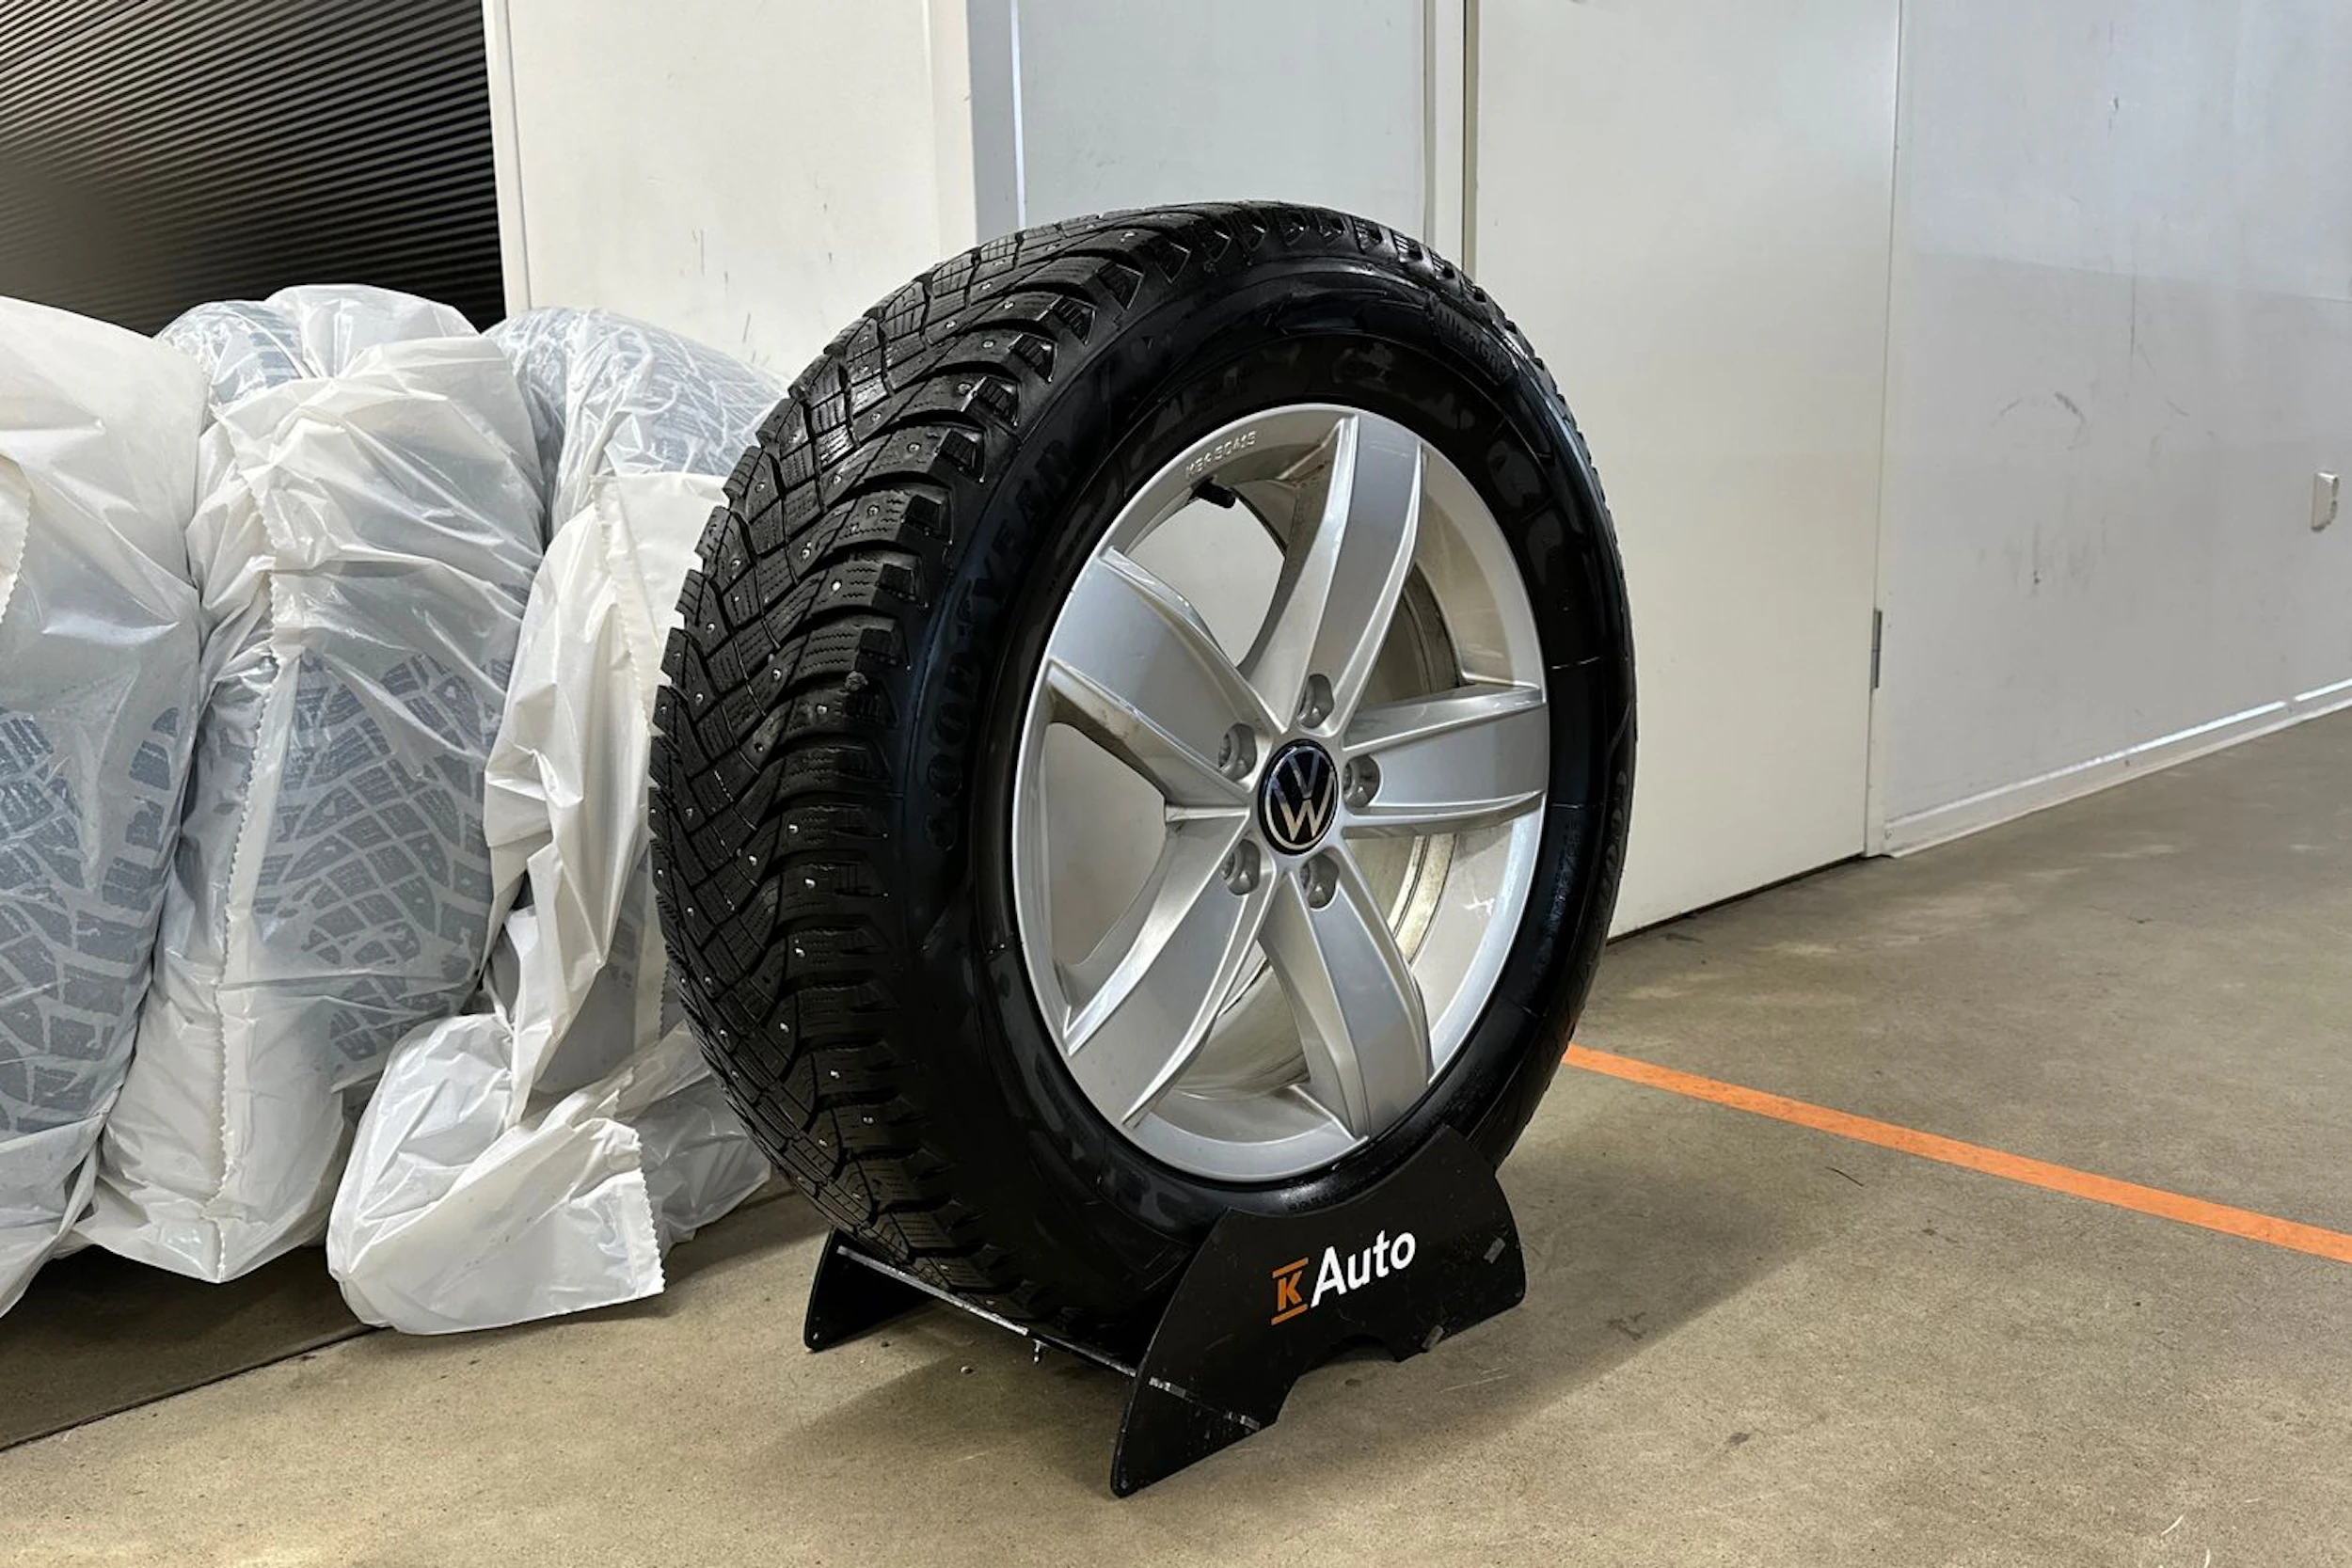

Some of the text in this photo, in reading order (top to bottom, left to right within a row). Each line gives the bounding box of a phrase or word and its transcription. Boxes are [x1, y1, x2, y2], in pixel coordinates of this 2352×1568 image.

[1269, 750, 1336, 843] VW
[1271, 1229, 1417, 1325] K Auto
